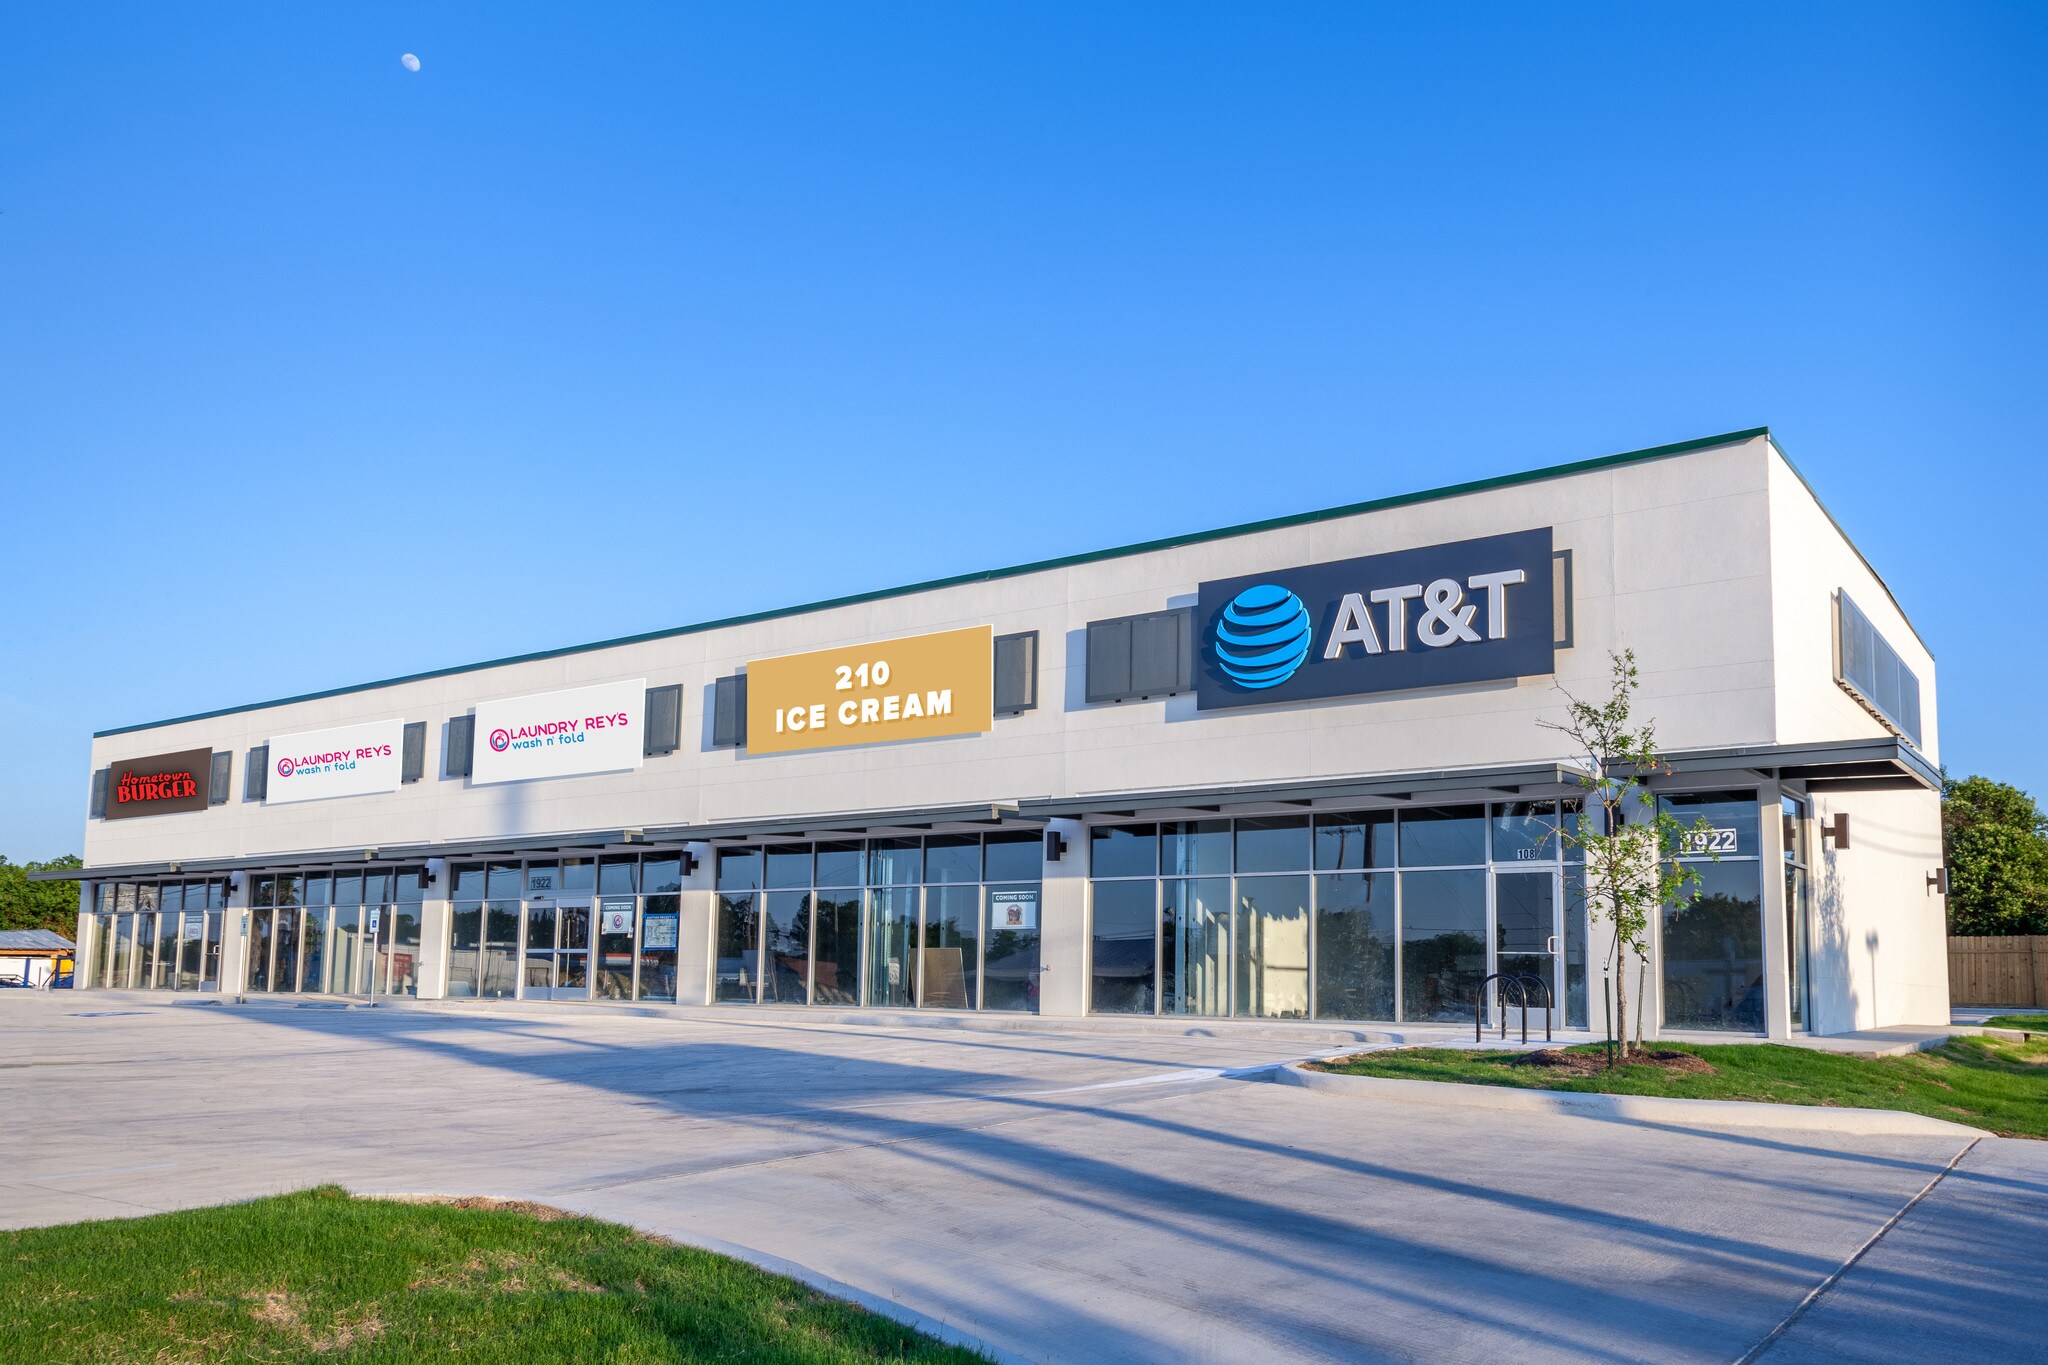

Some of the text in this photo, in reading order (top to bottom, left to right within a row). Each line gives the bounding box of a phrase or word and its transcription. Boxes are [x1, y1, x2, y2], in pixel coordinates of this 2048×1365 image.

[1323, 568, 1525, 660] AT&T
[835, 660, 890, 690] 210
[775, 689, 952, 733] ICE CREAM
[510, 712, 629, 740] LAUNDRY REY'S
[511, 737, 543, 750] wash
[558, 731, 585, 745] fold
[294, 744, 392, 767] LAUNDRY REY'S
[121, 770, 191, 786] Hometown
[296, 764, 321, 775] wash
[334, 760, 356, 771] fold
[117, 779, 197, 803] BURGER
[1518, 849, 1535, 859] 108
[531, 878, 551, 888] 1922
